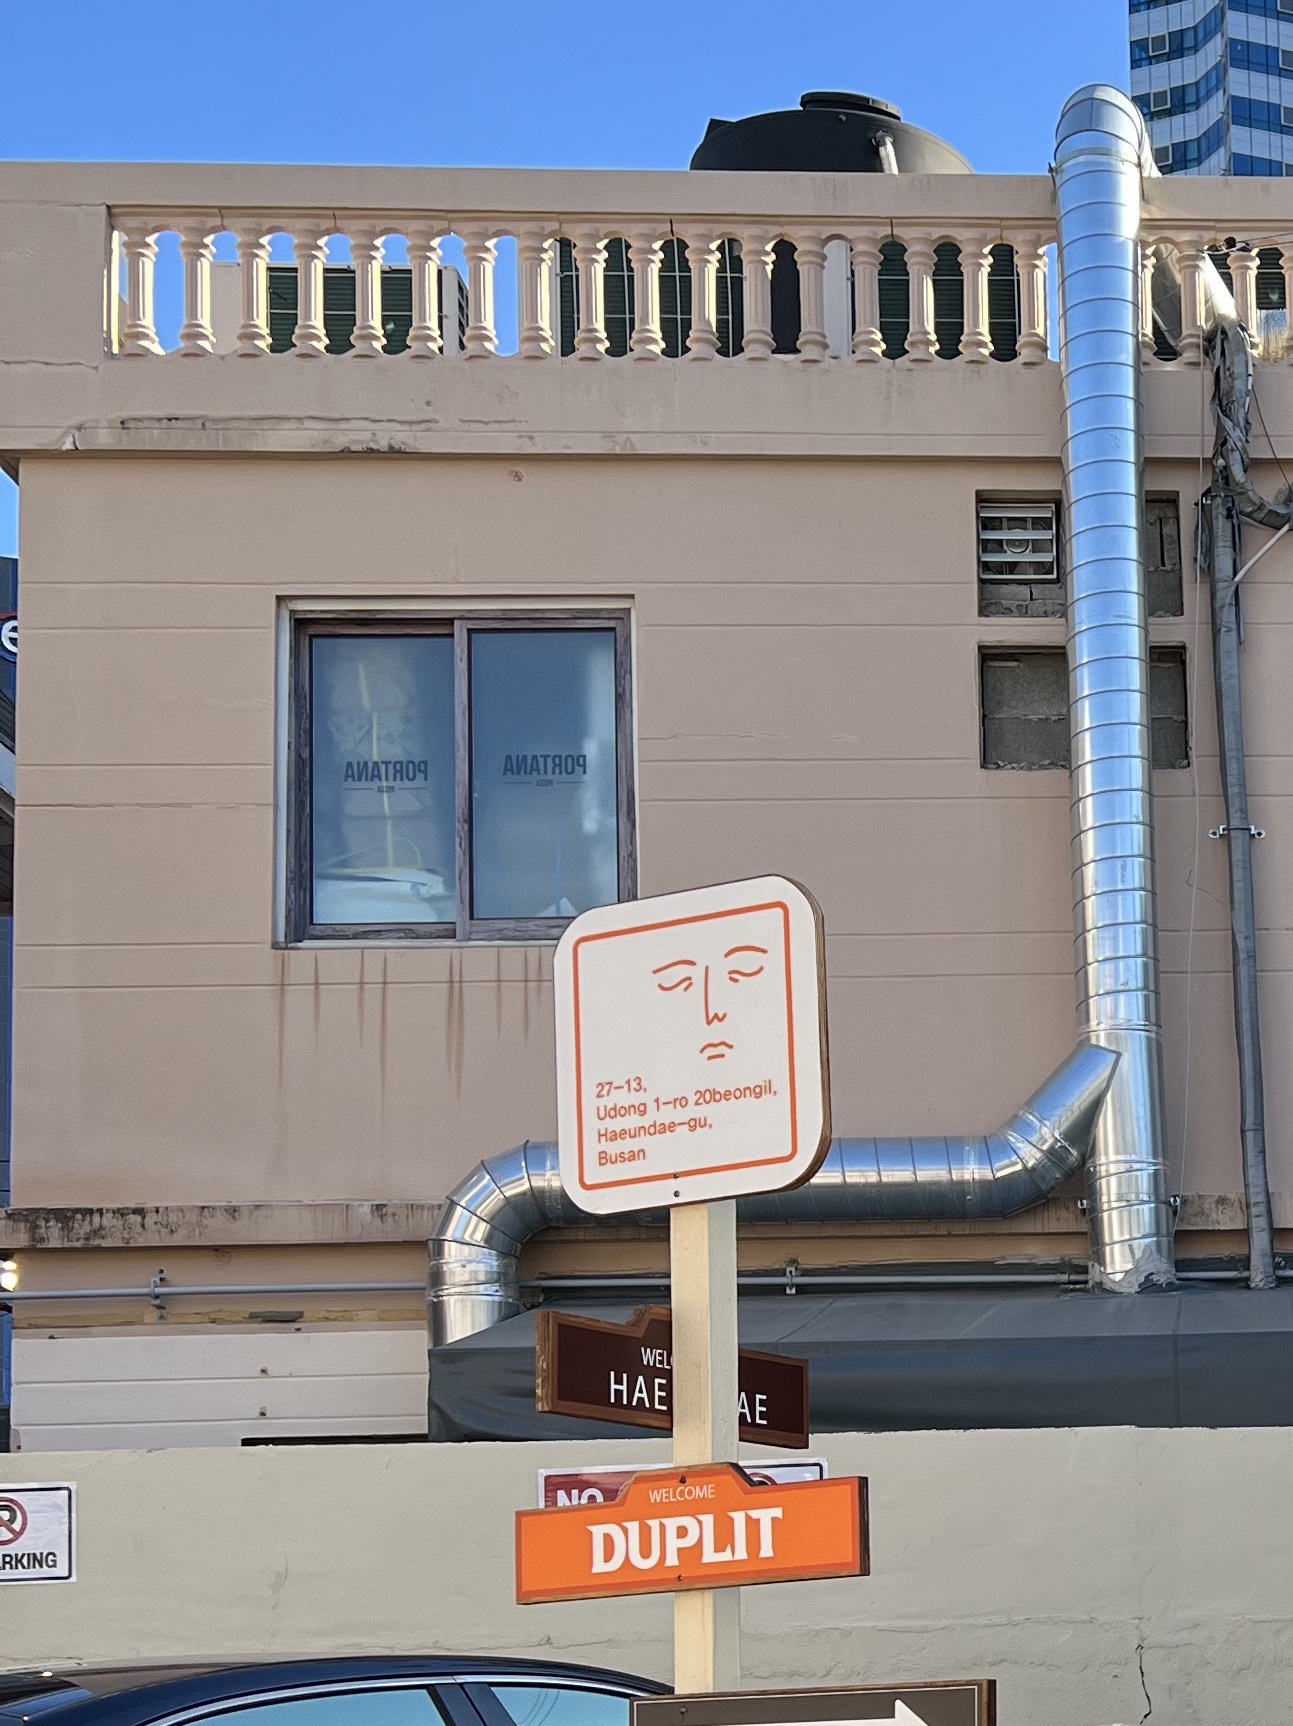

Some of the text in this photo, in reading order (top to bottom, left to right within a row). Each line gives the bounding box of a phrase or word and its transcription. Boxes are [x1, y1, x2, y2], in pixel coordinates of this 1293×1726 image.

[595, 1076, 647, 1099] 27-13,
[596, 1079, 778, 1121] Udong 1-ro 20beongil,
[597, 1115, 713, 1144] Haeundae-gu,
[598, 1148, 647, 1167] Busan
[648, 1483, 717, 1504] WELCOME
[585, 1506, 784, 1575] DUPLIT
[0, 1551, 58, 1571] RKING
